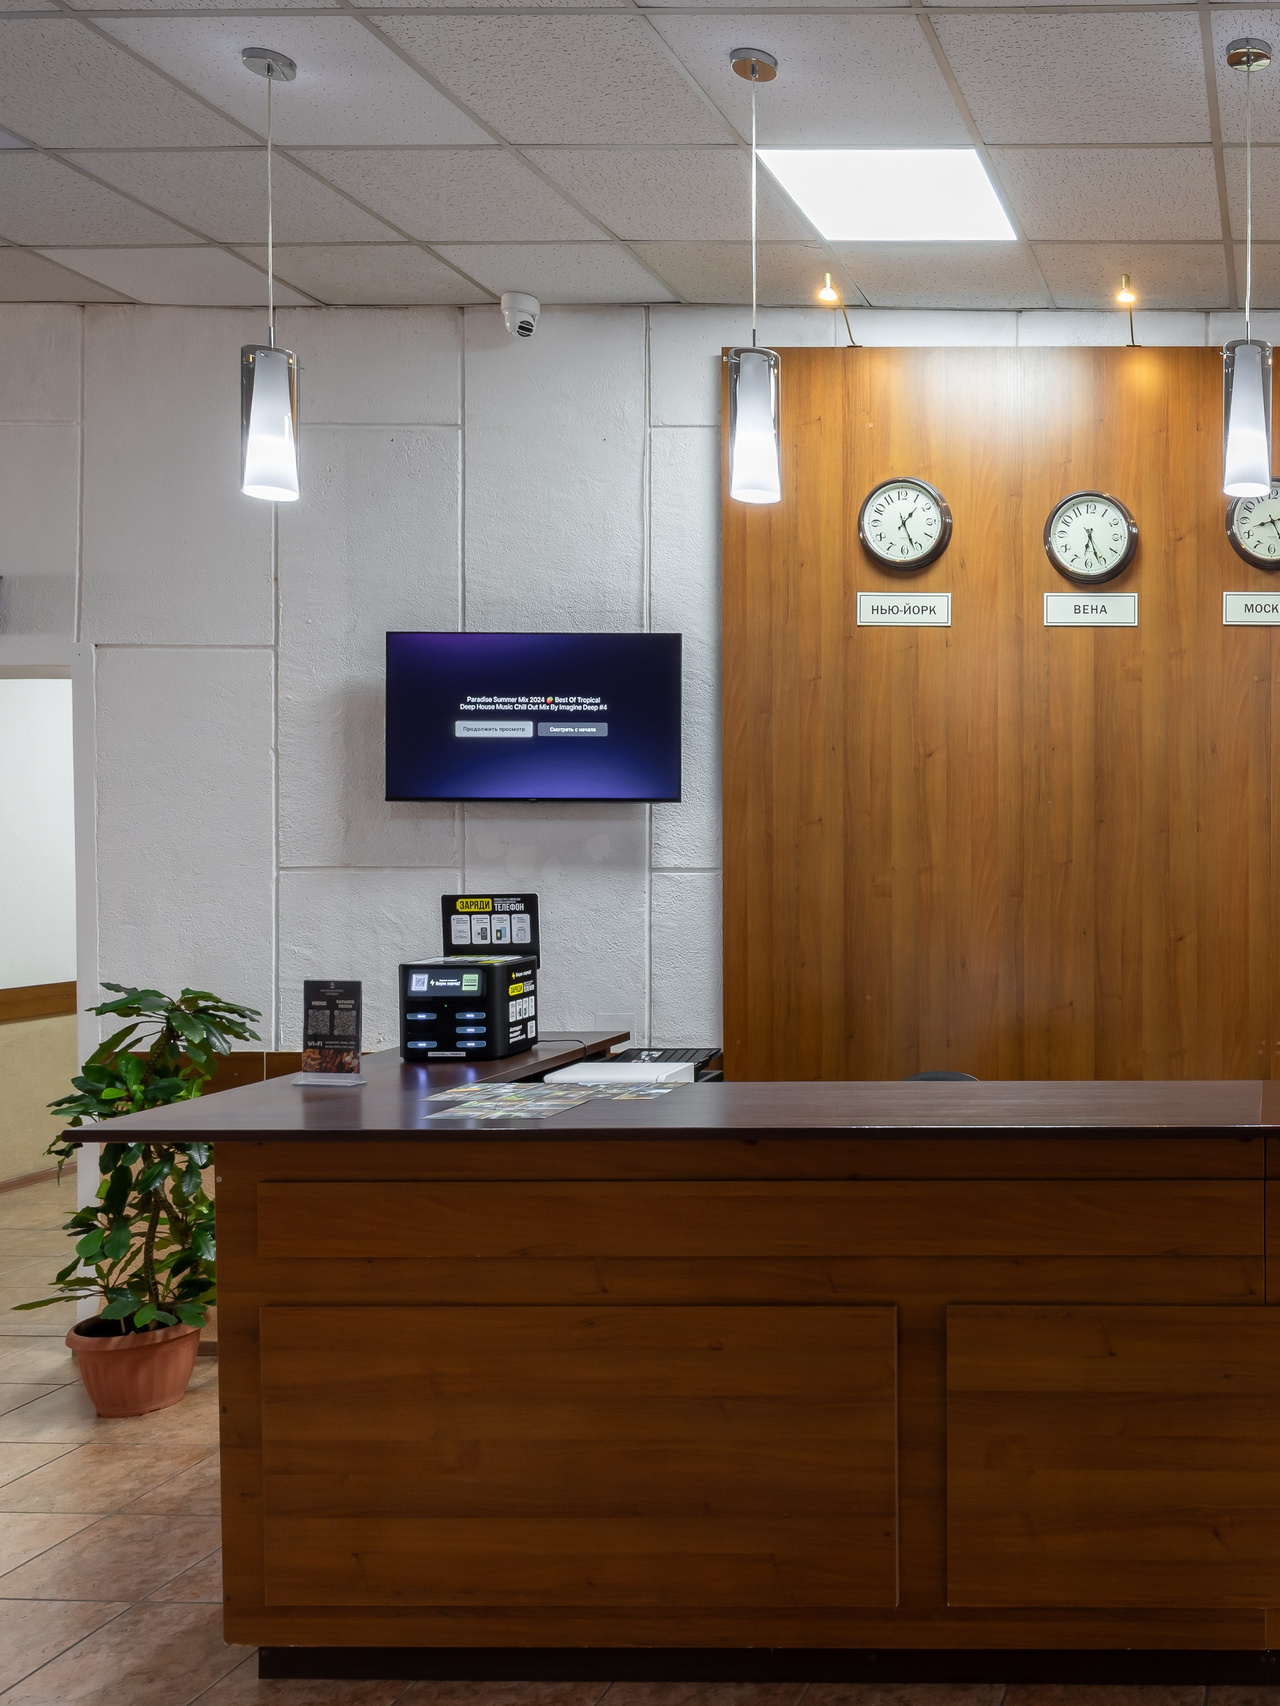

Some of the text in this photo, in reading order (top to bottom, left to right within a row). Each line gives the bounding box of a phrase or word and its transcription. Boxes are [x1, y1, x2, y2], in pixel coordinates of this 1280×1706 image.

[884, 495, 894, 505] 11
[898, 490, 908, 500] 12
[914, 494, 919, 503] 1
[874, 504, 885, 515] 10
[922, 503, 931, 512] 2
[1073, 507, 1082, 517] 11
[1086, 504, 1097, 514] 12
[1244, 501, 1255, 513] 10
[1102, 509, 1108, 517] 1
[1062, 515, 1073, 527] 10
[1109, 518, 1119, 527] 2
[876, 532, 886, 542] 8
[1243, 530, 1254, 539] 8
[887, 542, 896, 551] 7
[1061, 544, 1071, 553] 8
[1253, 540, 1264, 549] 7
[1268, 544, 1275, 554] 6
[901, 545, 909, 555] 6
[1085, 558, 1092, 568] 6
[871, 603, 937, 615] НЬЮ-ЙОРК
[1073, 604, 1108, 615] ВЕНА
[460, 900, 524, 911] ЗАРЯДИ ТЕЛЕФОН
